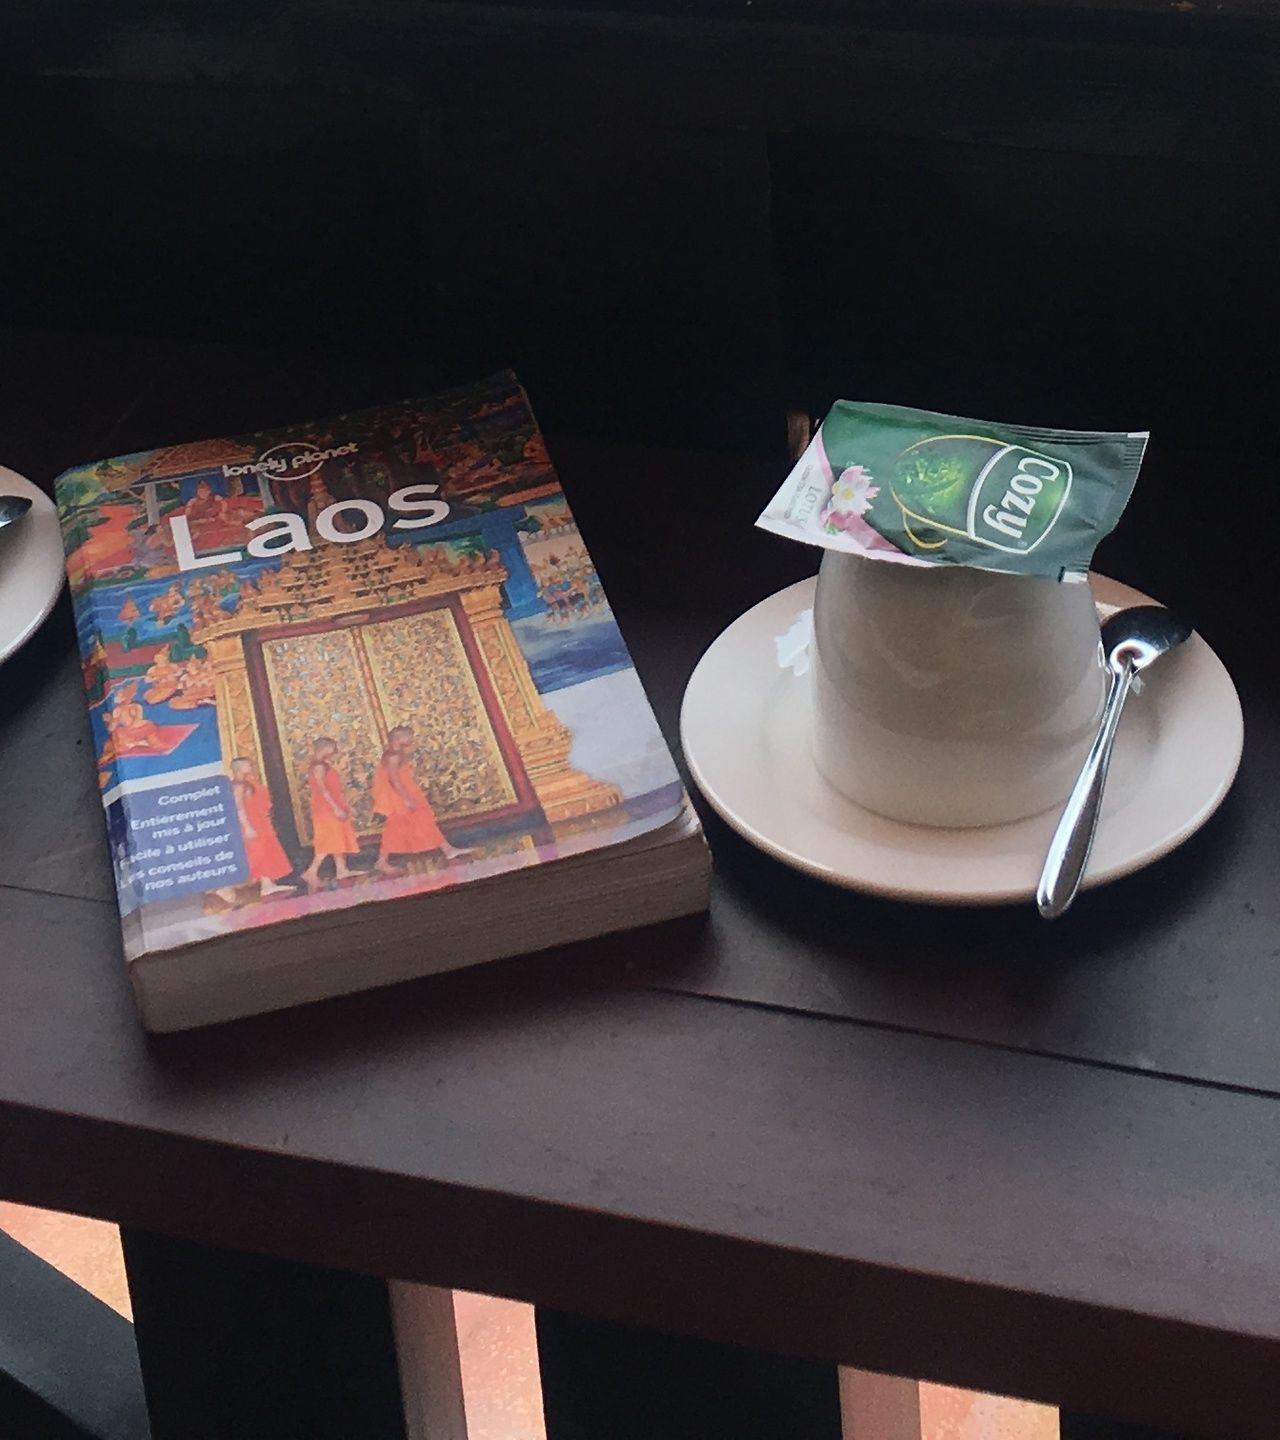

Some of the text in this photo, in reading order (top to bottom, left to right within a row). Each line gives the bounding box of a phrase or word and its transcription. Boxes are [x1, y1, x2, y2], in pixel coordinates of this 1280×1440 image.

[222, 442, 359, 477] lonely planet
[983, 458, 1060, 539] Cozy
[169, 483, 450, 571] Laos
[158, 785, 221, 806] Complet
[152, 826, 180, 839] mis
[197, 816, 227, 833] jour
[177, 833, 232, 852] utiliser
[148, 855, 212, 876] conseils
[214, 850, 234, 862] de
[145, 863, 238, 891] nos auteurs
